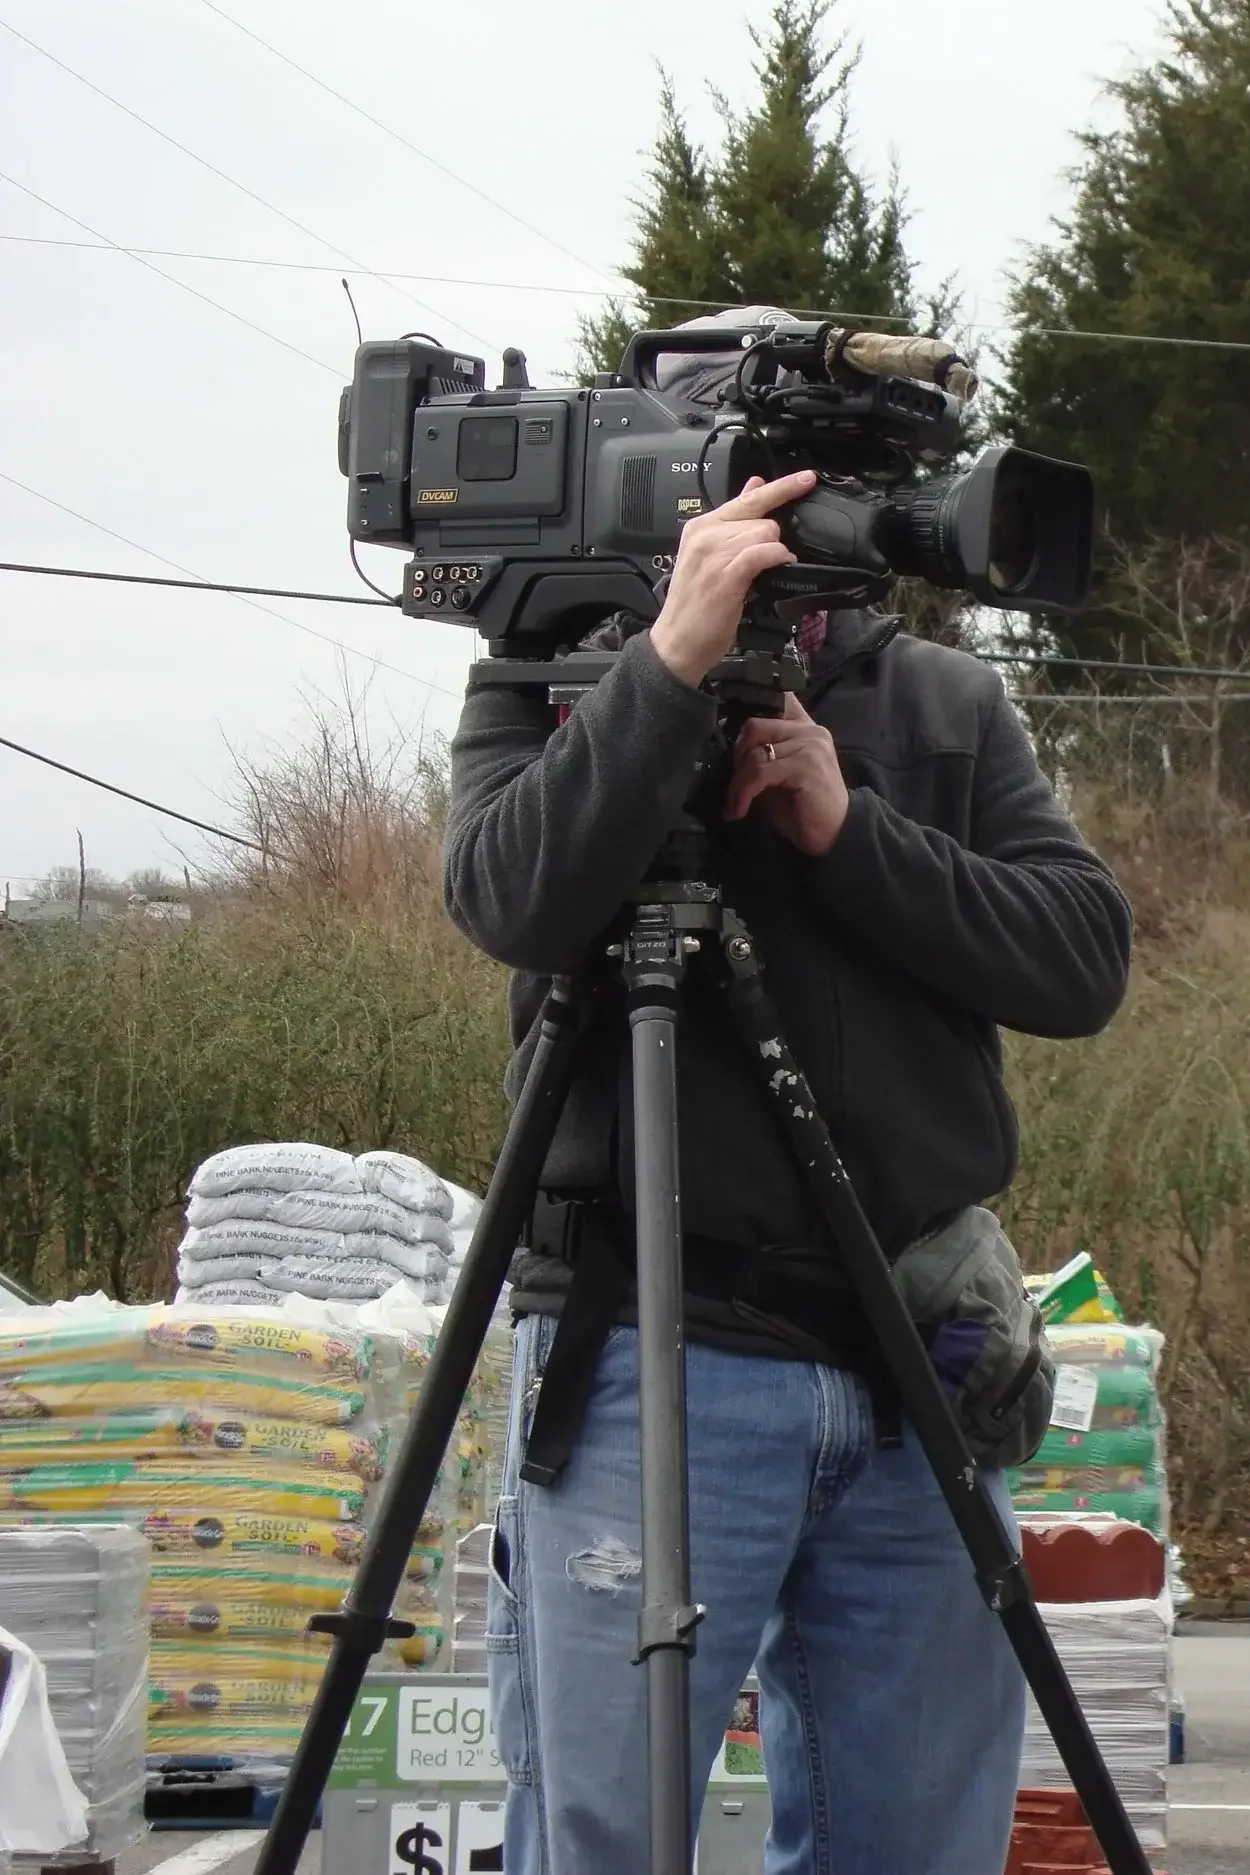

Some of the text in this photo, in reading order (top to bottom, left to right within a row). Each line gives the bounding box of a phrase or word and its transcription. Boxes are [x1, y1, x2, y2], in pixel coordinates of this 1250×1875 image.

[671, 462, 713, 472] SONY
[421, 491, 454, 501] DVCAM
[215, 1169, 236, 1179] PINE
[228, 1321, 301, 1342] GARDEN
[254, 1423, 327, 1441] GARDEN
[235, 1515, 309, 1534] GARDEN
[410, 1748, 503, 1768] Red 12" S
